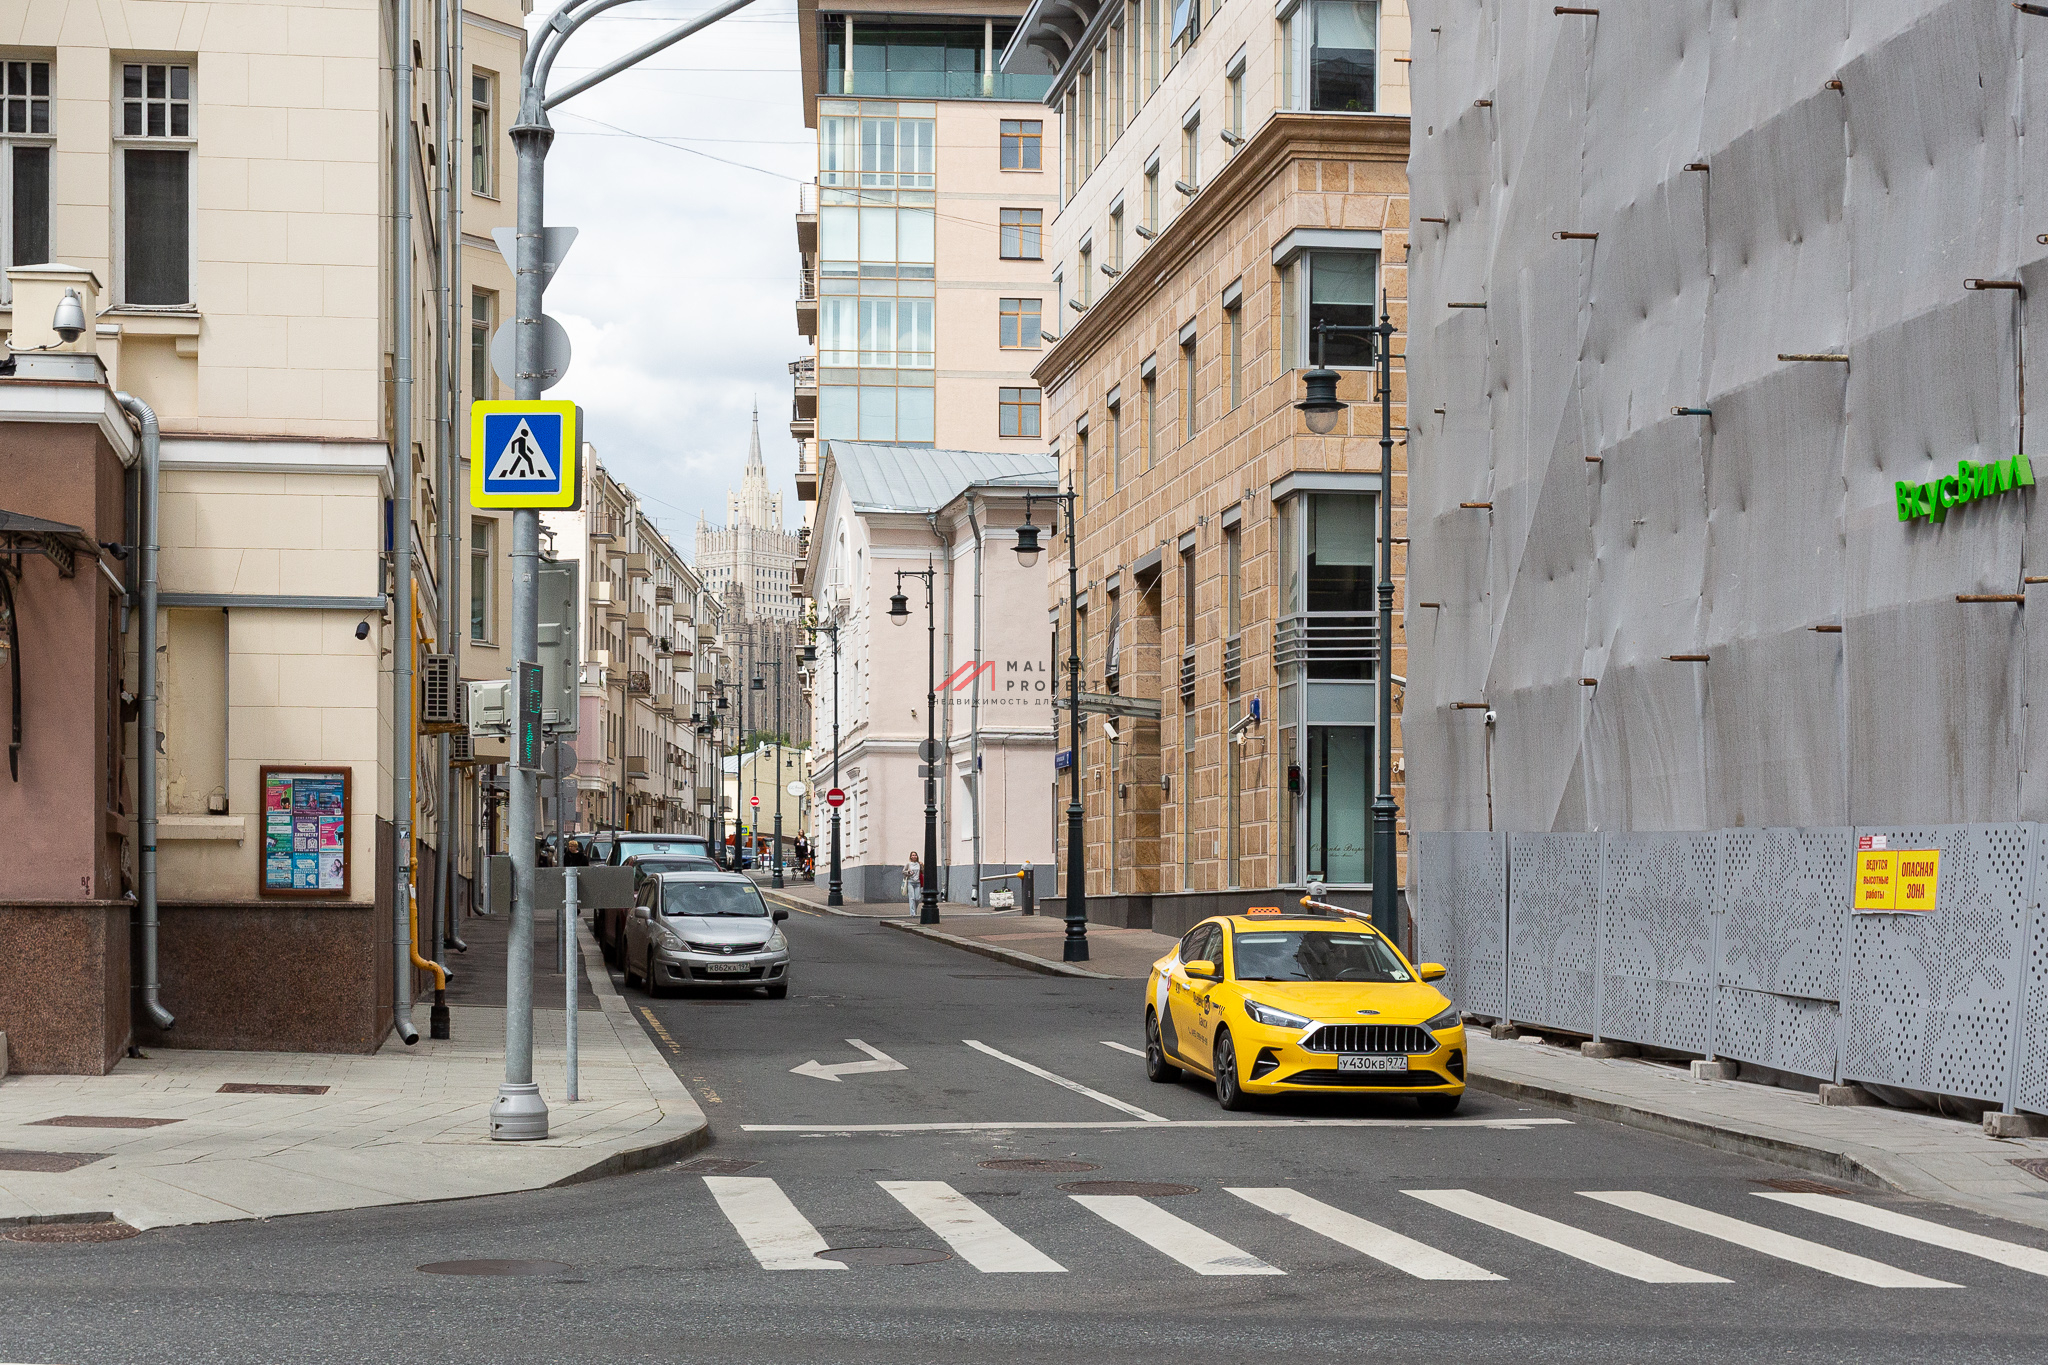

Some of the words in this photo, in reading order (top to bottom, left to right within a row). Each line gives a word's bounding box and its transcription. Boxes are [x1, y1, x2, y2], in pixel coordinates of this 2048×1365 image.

[1865, 859, 1888, 871] ВЕДУТСЯ
[1901, 861, 1934, 877] ОПАСНАЯ
[1865, 889, 1885, 900] работы
[1906, 883, 1925, 899] ЗОНА
